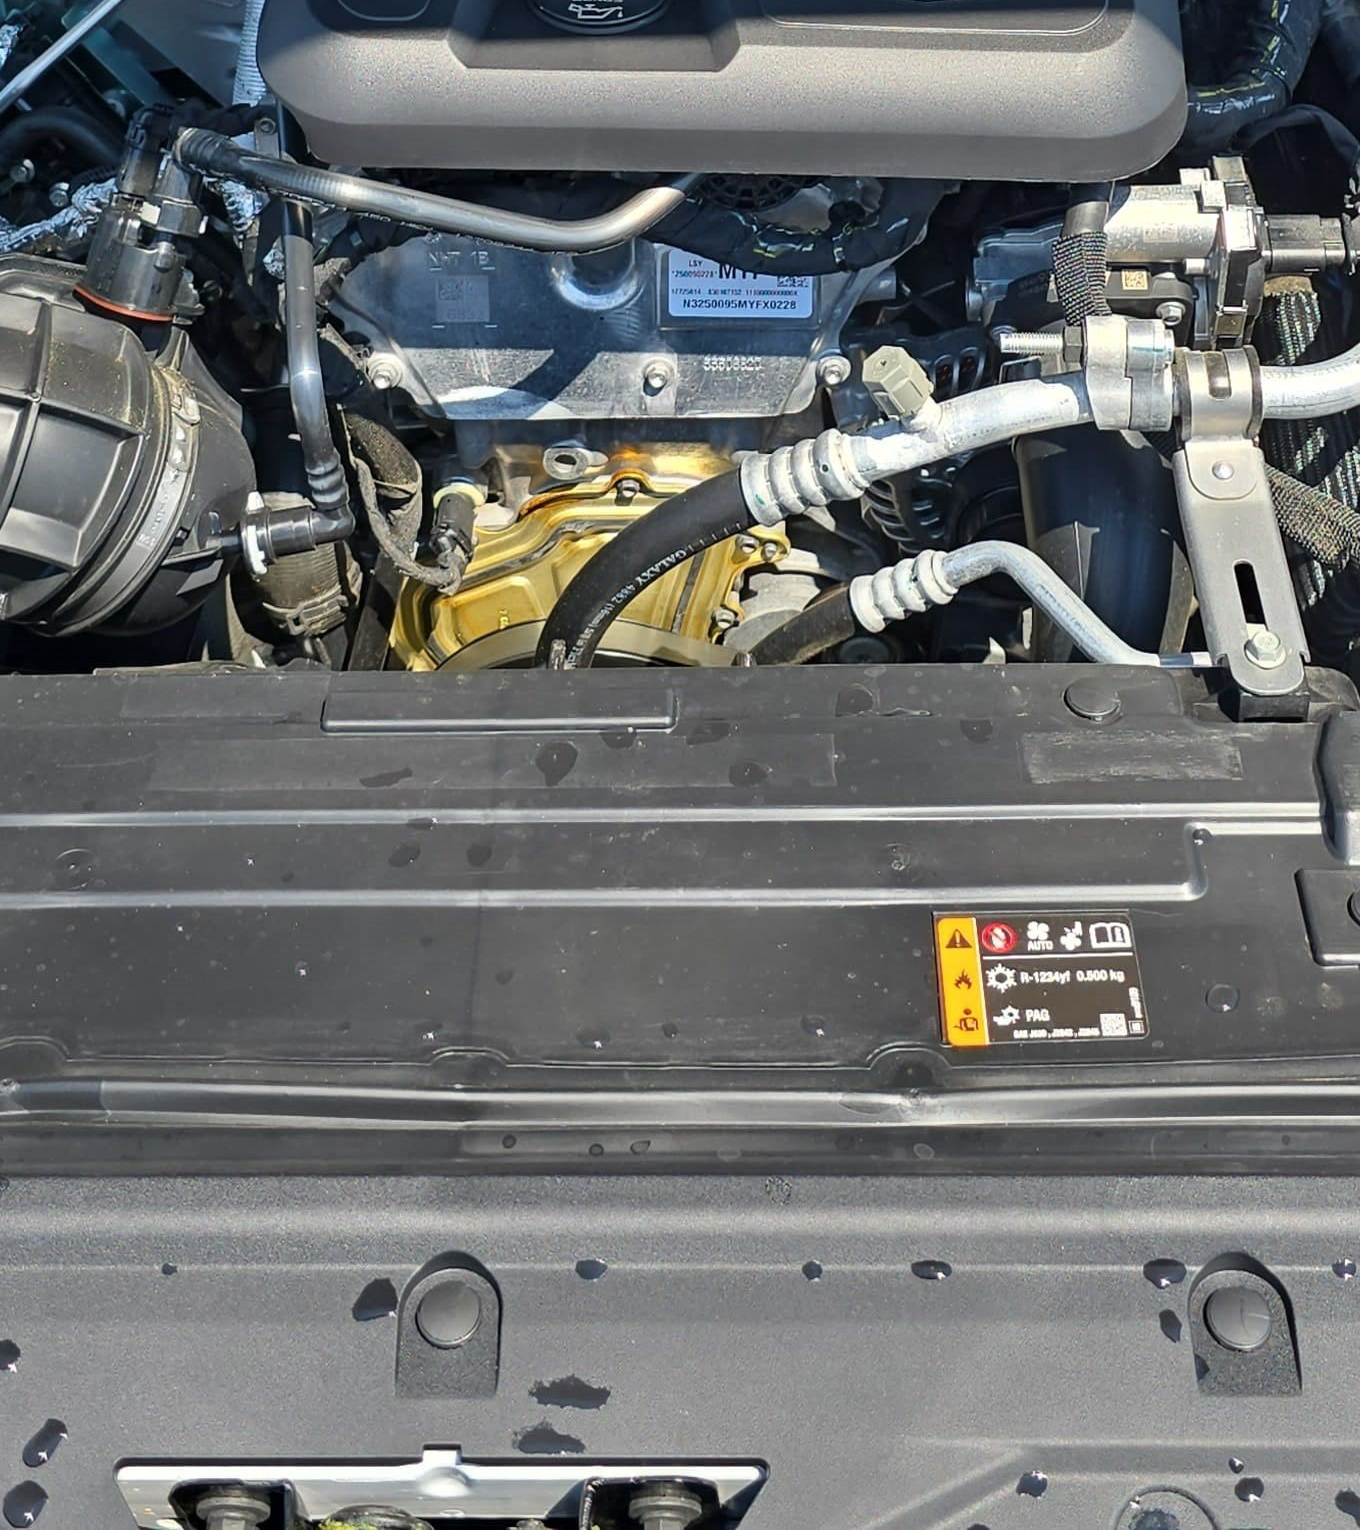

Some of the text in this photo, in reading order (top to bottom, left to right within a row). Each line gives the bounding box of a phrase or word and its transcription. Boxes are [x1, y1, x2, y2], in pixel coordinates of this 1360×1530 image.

[635, 549, 687, 585] GALAXY
[1027, 940, 1054, 951] AUTO
[1019, 969, 1125, 985] R-1234yf 0.500 kg
[1026, 1008, 1051, 1022] PAG
